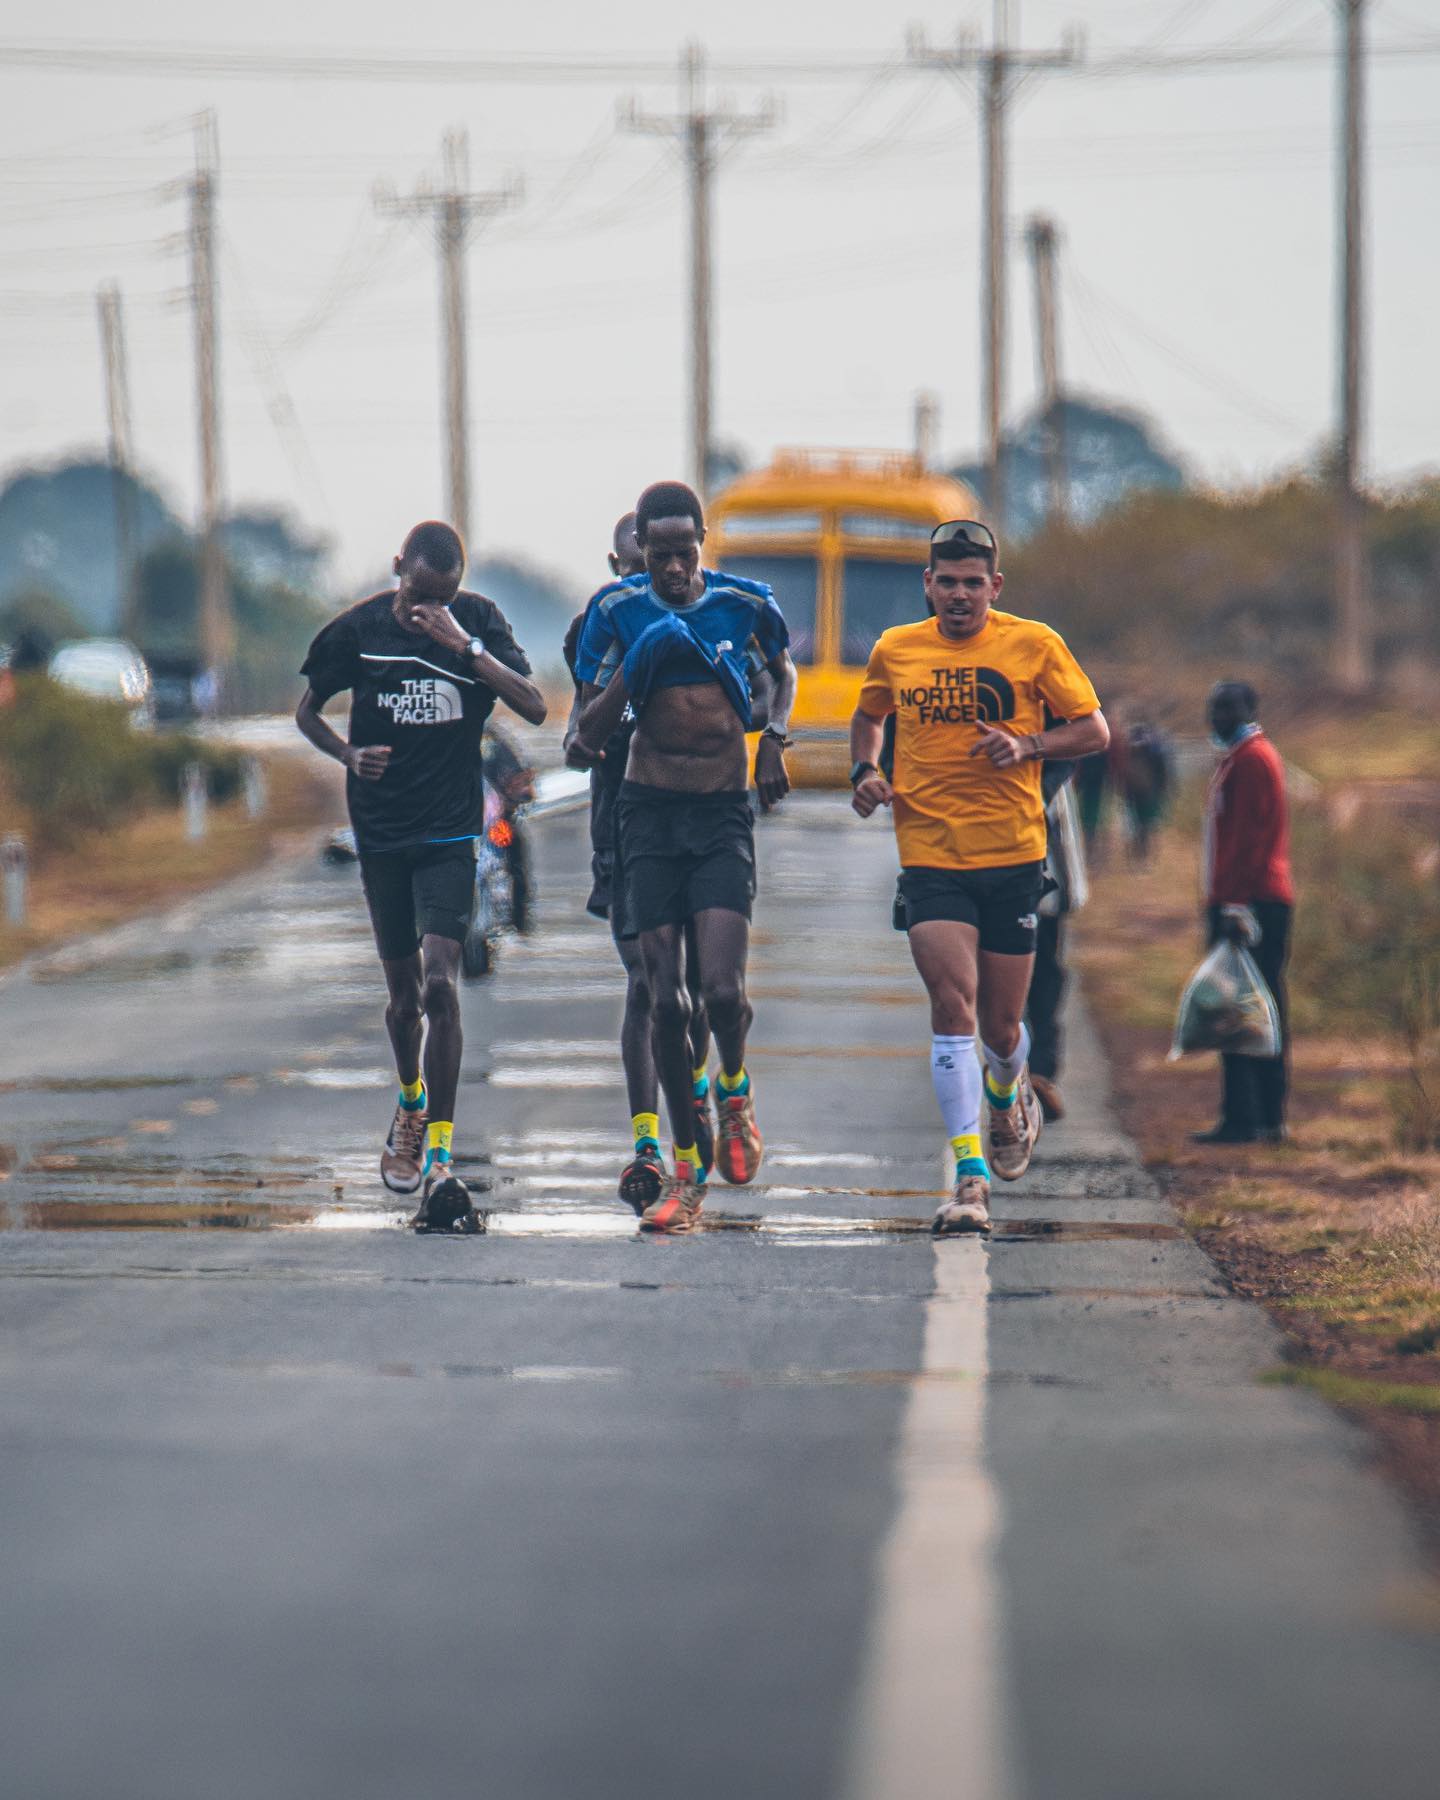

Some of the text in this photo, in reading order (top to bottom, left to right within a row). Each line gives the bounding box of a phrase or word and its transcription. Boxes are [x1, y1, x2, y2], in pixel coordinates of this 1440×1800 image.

[931, 667, 973, 686] THE
[401, 679, 434, 695] THE
[377, 693, 434, 709] NORTH
[900, 686, 974, 707] NORTH
[393, 708, 434, 724] FACE
[919, 705, 975, 724] FACE
